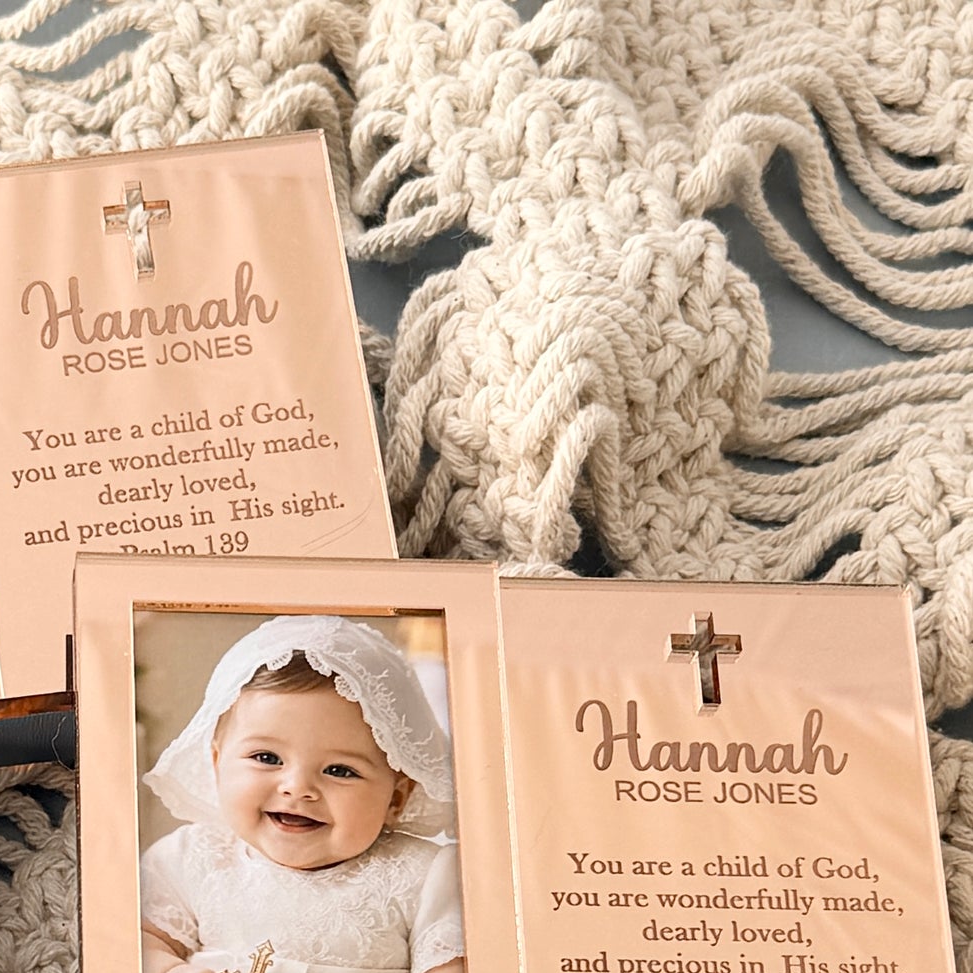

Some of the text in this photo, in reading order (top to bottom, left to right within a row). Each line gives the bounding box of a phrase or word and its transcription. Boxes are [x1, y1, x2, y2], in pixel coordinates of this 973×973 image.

[21, 261, 279, 349] Hannah
[63, 334, 253, 377] ROSE JONES
[22, 400, 314, 452] You are a child of God,
[11, 429, 339, 488] you are wonderfully made,
[98, 469, 256, 507] dearly loved,
[24, 490, 345, 546] and precious in His sight.
[120, 531, 249, 555] Plm 139
[575, 699, 848, 776] Hannah
[615, 781, 818, 805] ROSE JONES
[567, 853, 879, 883] You are a child of God,
[551, 889, 904, 916] you are wonderfully made,
[642, 920, 813, 948] dearly loved,
[560, 952, 609, 973] and
